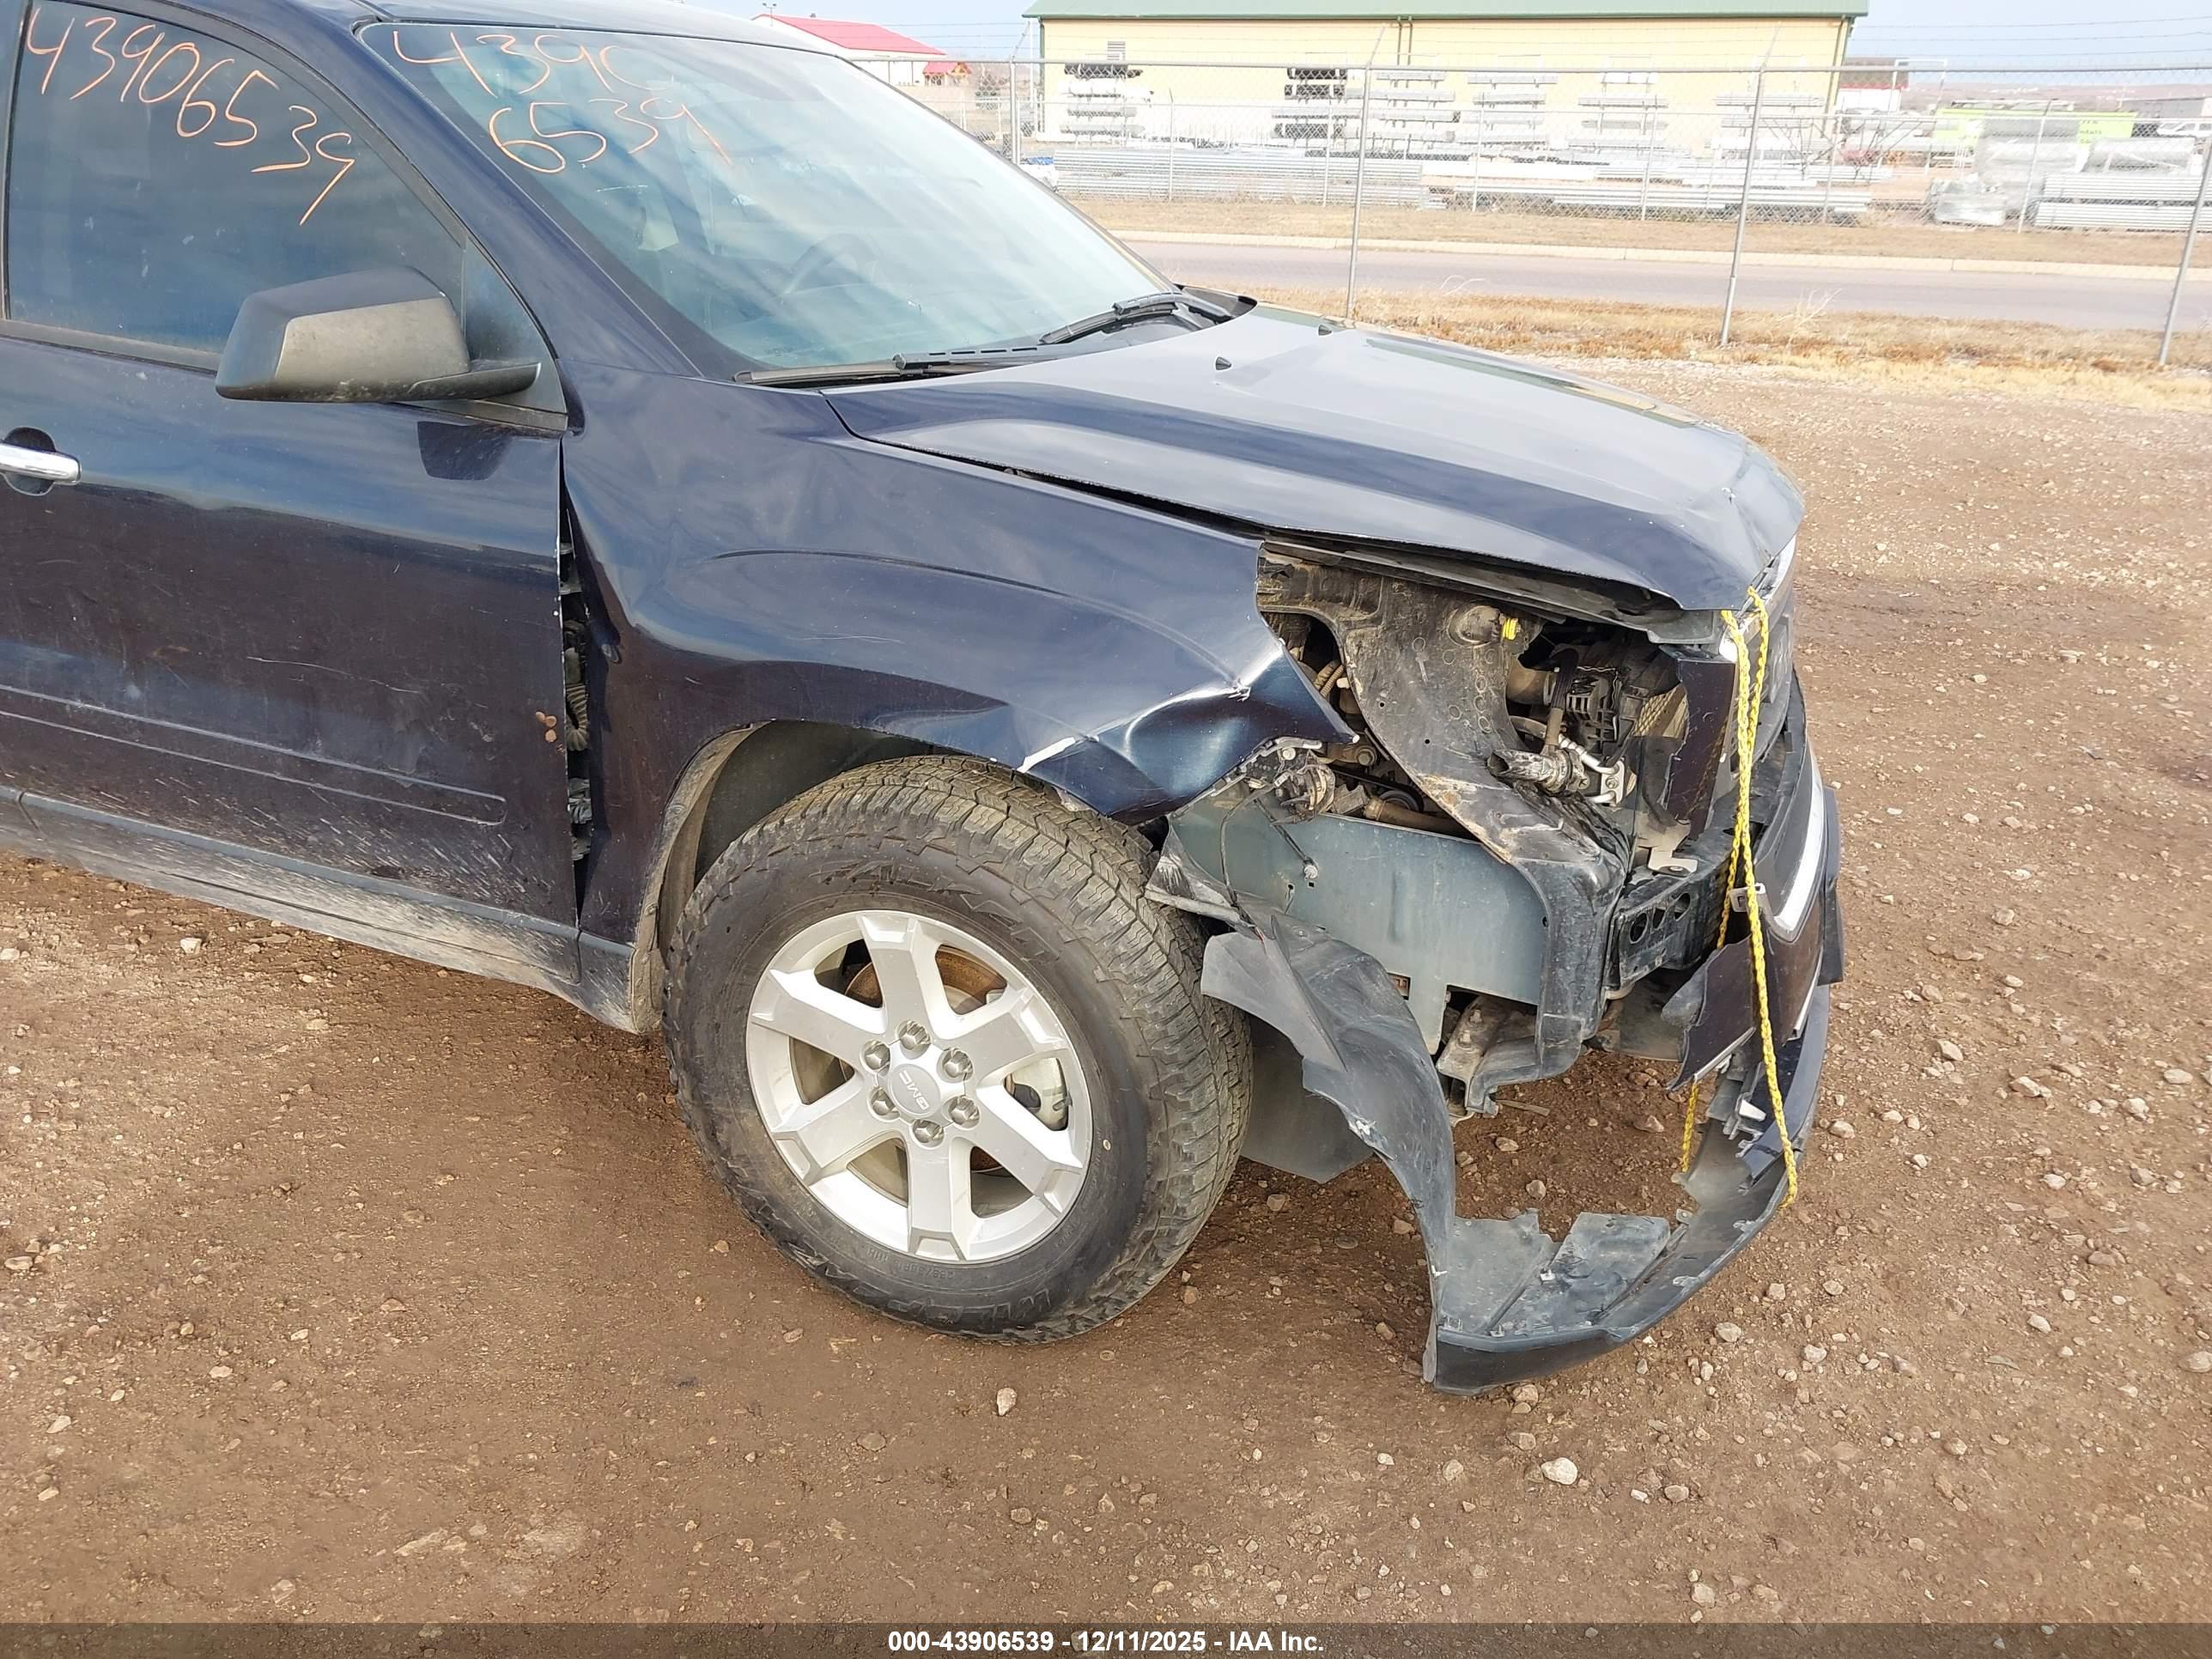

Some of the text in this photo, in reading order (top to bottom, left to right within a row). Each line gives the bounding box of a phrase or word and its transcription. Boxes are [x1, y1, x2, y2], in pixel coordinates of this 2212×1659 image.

[27, 8, 355, 226] 43906539
[489, 98, 732, 173] 6539
[899, 1070, 930, 1110] GMC
